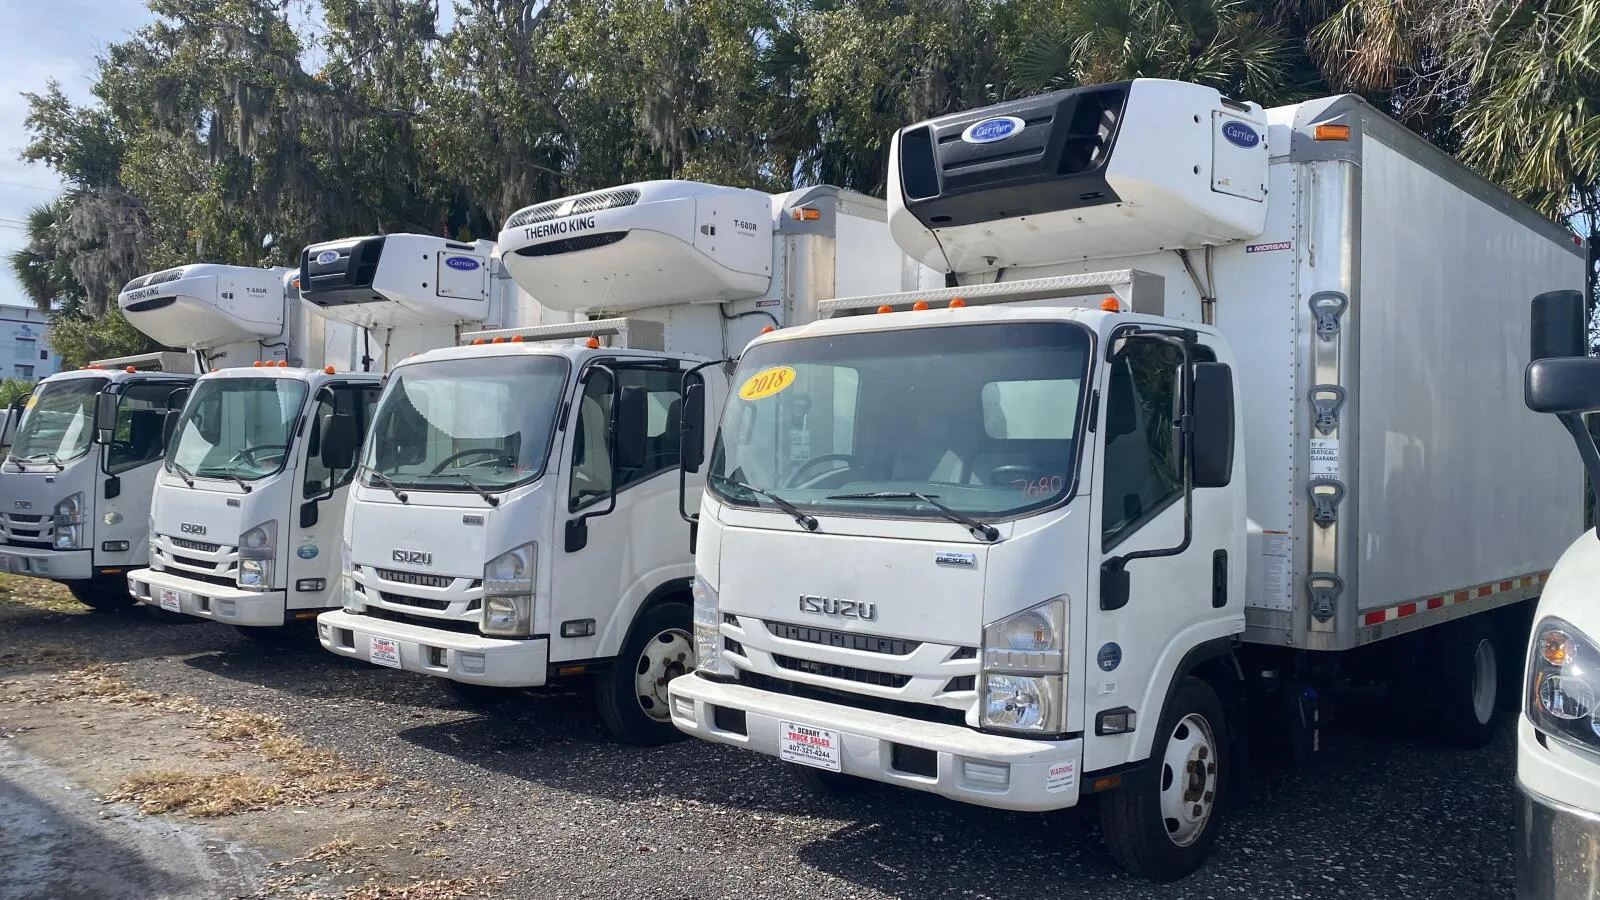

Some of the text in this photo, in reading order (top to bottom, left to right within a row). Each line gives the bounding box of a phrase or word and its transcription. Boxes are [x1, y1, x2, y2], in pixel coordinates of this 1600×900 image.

[974, 120, 1011, 139] Carrier
[1226, 126, 1255, 143] Carrier
[525, 216, 595, 240] THERMO KING
[734, 219, 757, 231] T-680R
[1254, 243, 1290, 252] MORGAN
[450, 258, 475, 268] Carrier
[127, 286, 159, 301] THERMO KING
[747, 370, 787, 397] 2018
[1011, 475, 1062, 500] 7680
[181, 523, 207, 535] ISUZU
[393, 549, 432, 566] ISUZU
[935, 556, 973, 565] DIESEL
[799, 593, 877, 621] ISUZU
[788, 731, 830, 747] TRUCK SALES
[797, 727, 820, 738] DEBARY
[789, 744, 830, 759] 407-321-4244
[1049, 765, 1073, 776] WARNING
